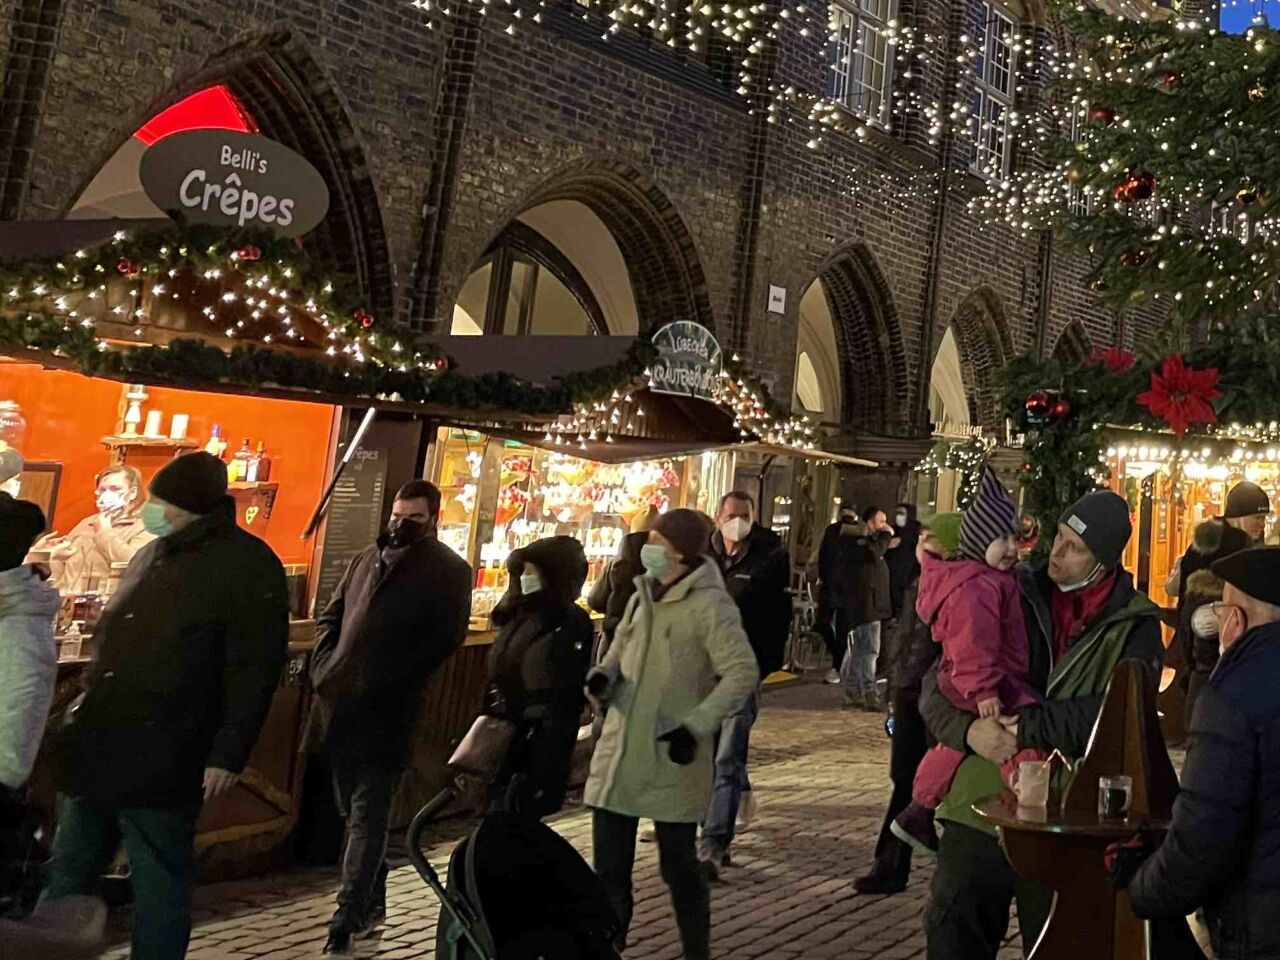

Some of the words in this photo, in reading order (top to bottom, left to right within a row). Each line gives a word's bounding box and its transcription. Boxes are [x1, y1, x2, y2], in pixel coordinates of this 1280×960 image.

[220, 145, 268, 174] Belli's
[179, 169, 295, 227] Crêpes
[289, 659, 304, 675] 59
